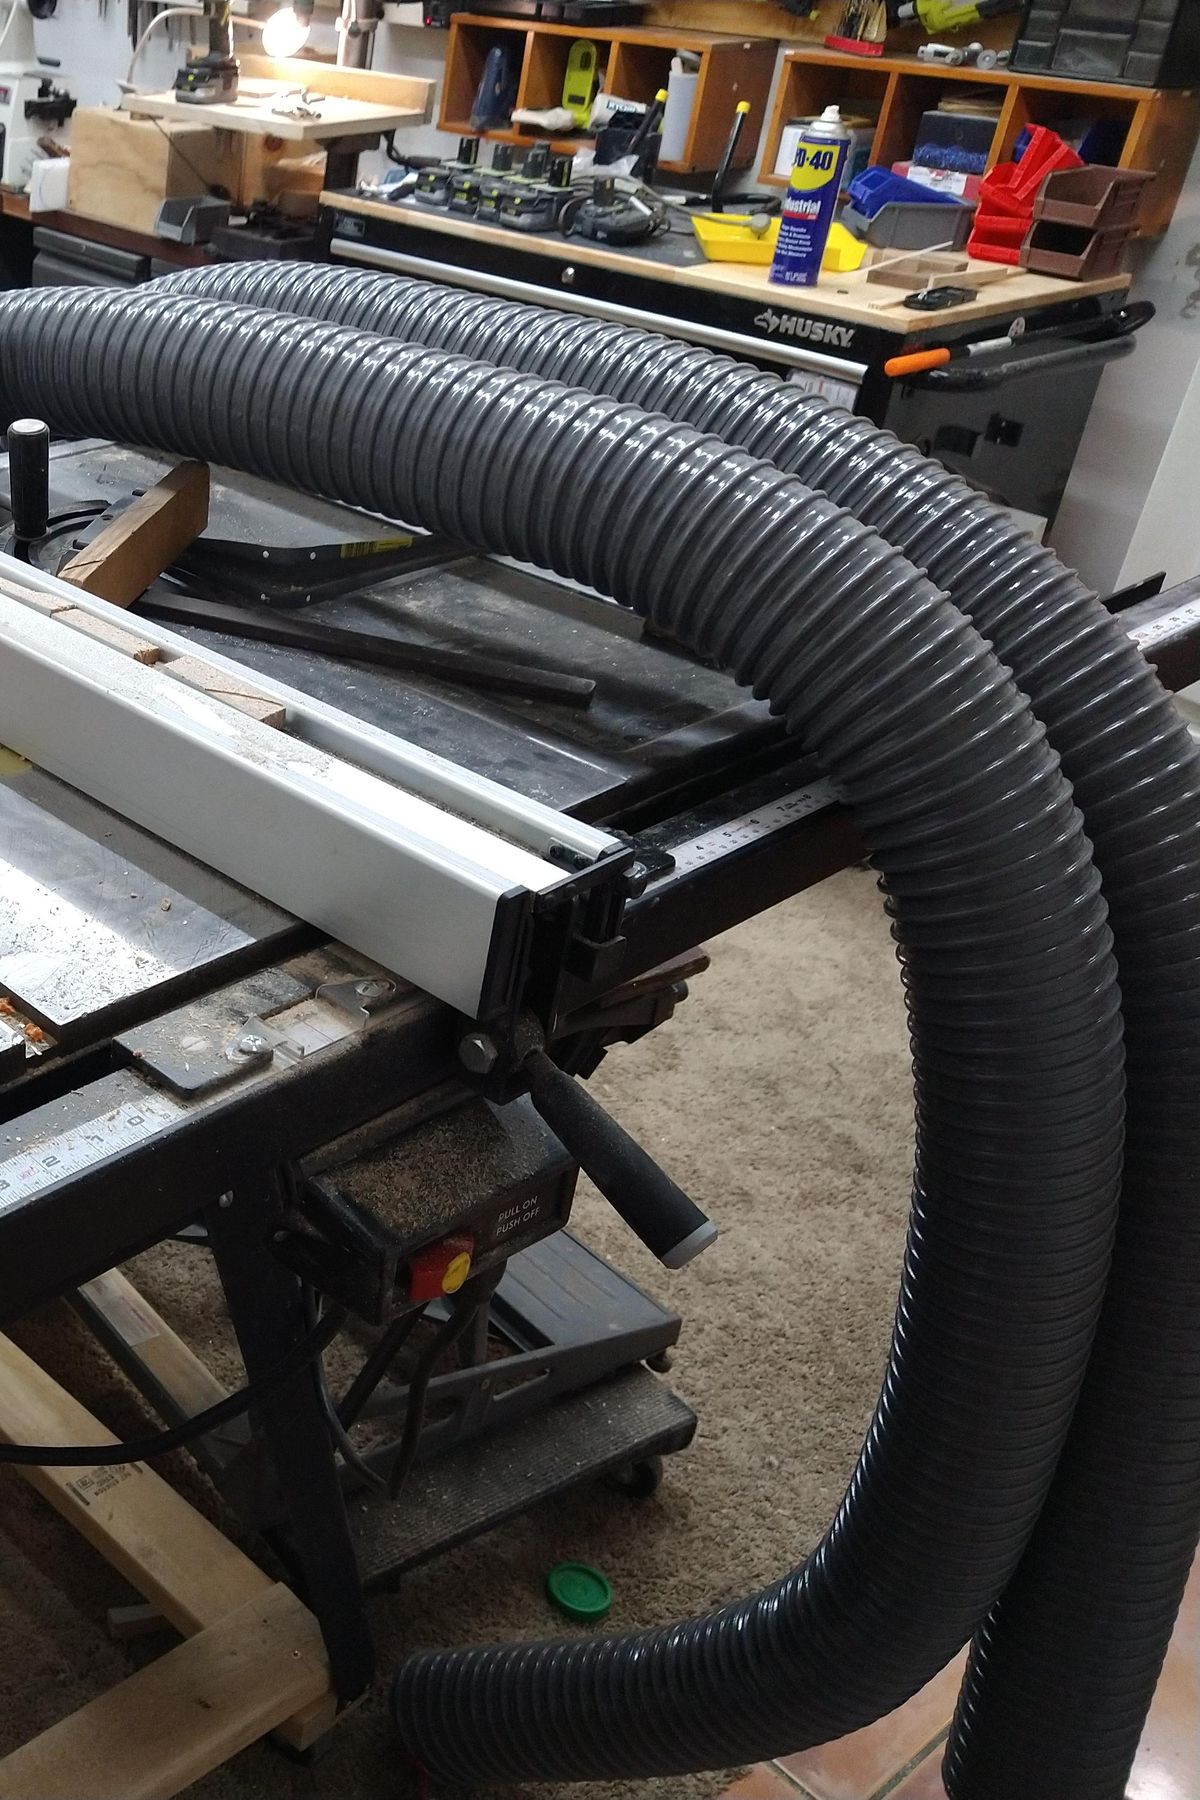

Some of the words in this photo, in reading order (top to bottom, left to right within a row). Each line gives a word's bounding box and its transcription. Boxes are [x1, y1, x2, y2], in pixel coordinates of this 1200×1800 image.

[792, 148, 833, 170] D-40
[779, 314, 856, 347] HUSKY
[41, 1155, 61, 1167] 2
[127, 1115, 145, 1126] 0
[496, 1217, 520, 1236] PUSH
[523, 1207, 540, 1221] OFF
[499, 1205, 520, 1222] PULL
[522, 1195, 538, 1209] ON
